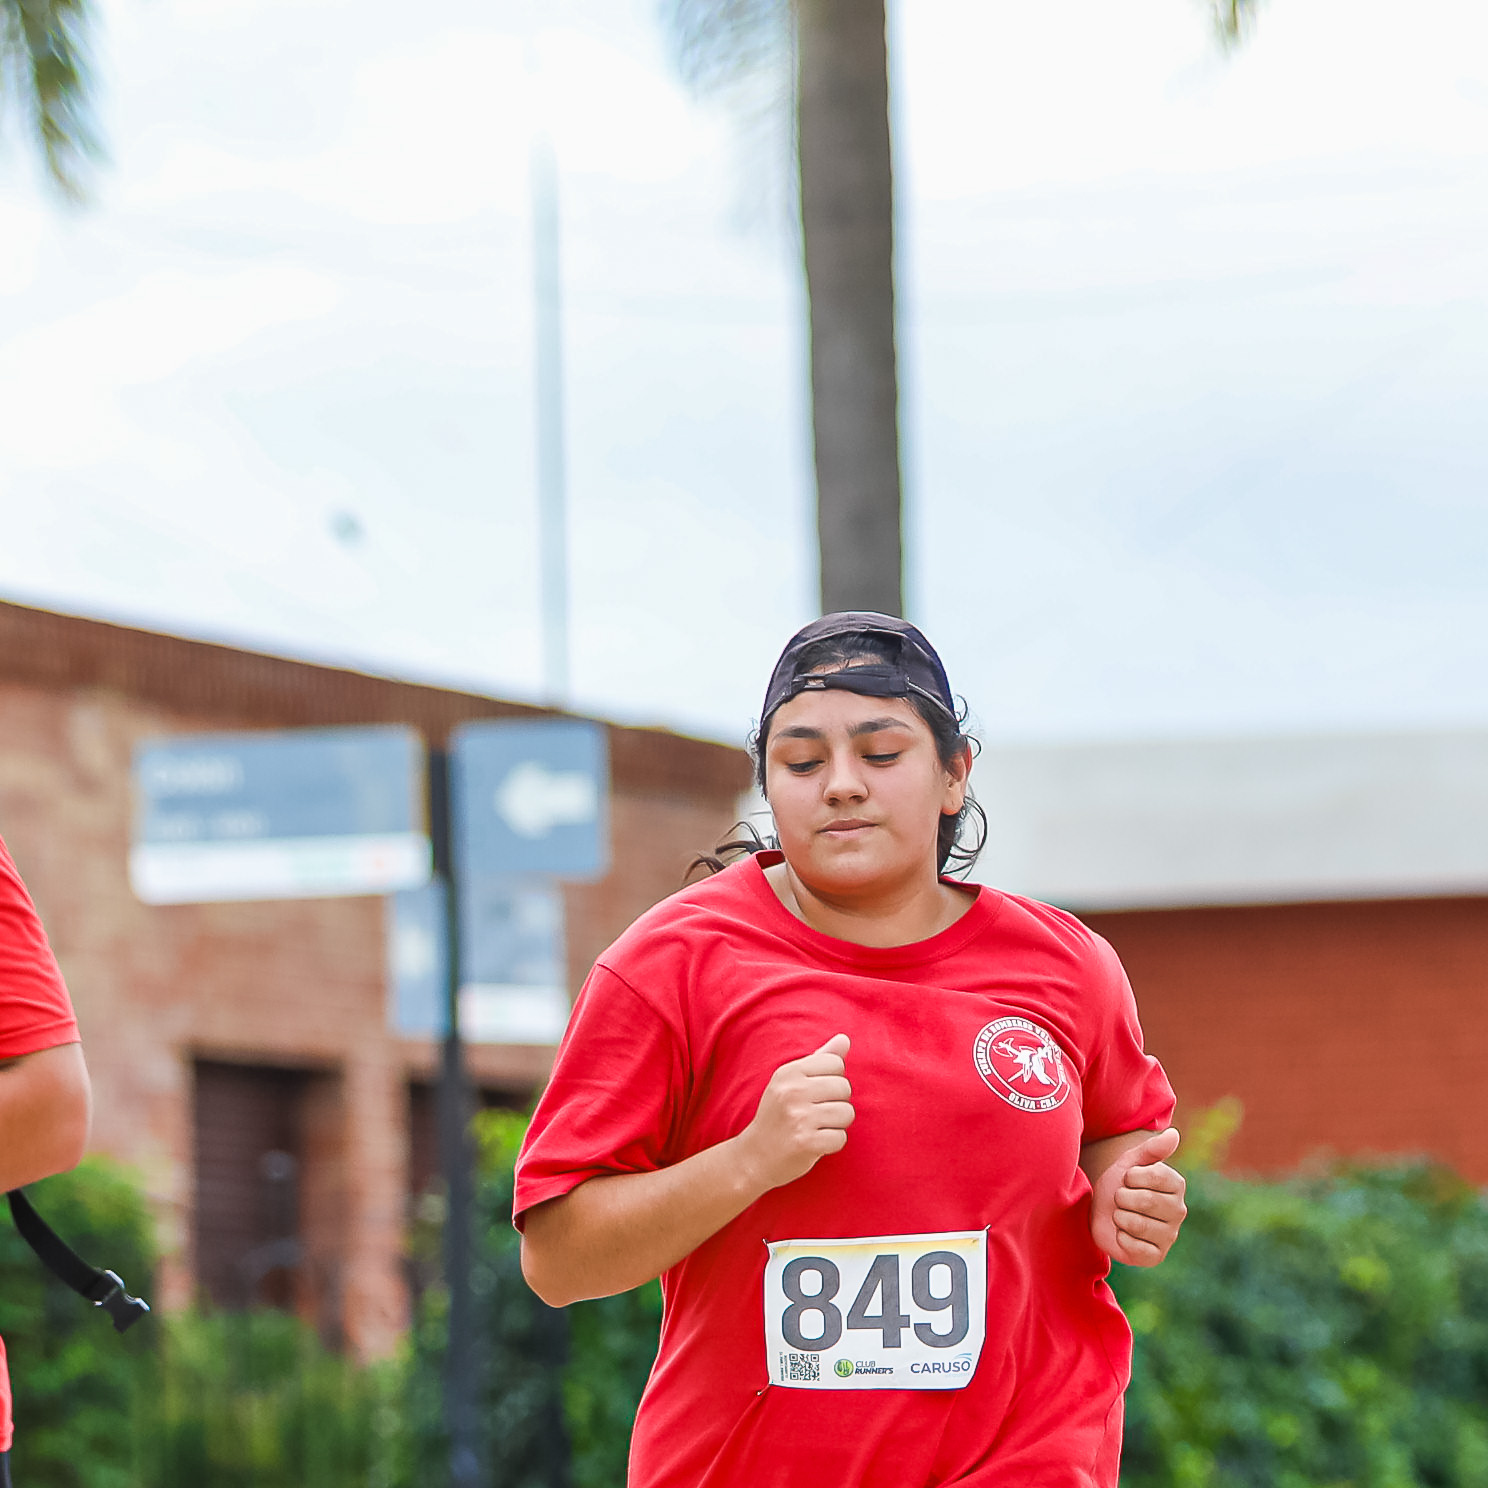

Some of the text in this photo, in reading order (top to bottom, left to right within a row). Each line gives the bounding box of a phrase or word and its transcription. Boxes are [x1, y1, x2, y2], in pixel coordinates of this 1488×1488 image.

[1008, 1092, 1036, 1110] OLIVA
[781, 1250, 970, 1351] 849
[855, 1360, 876, 1368] CLUB
[910, 1360, 971, 1374] CARUSO
